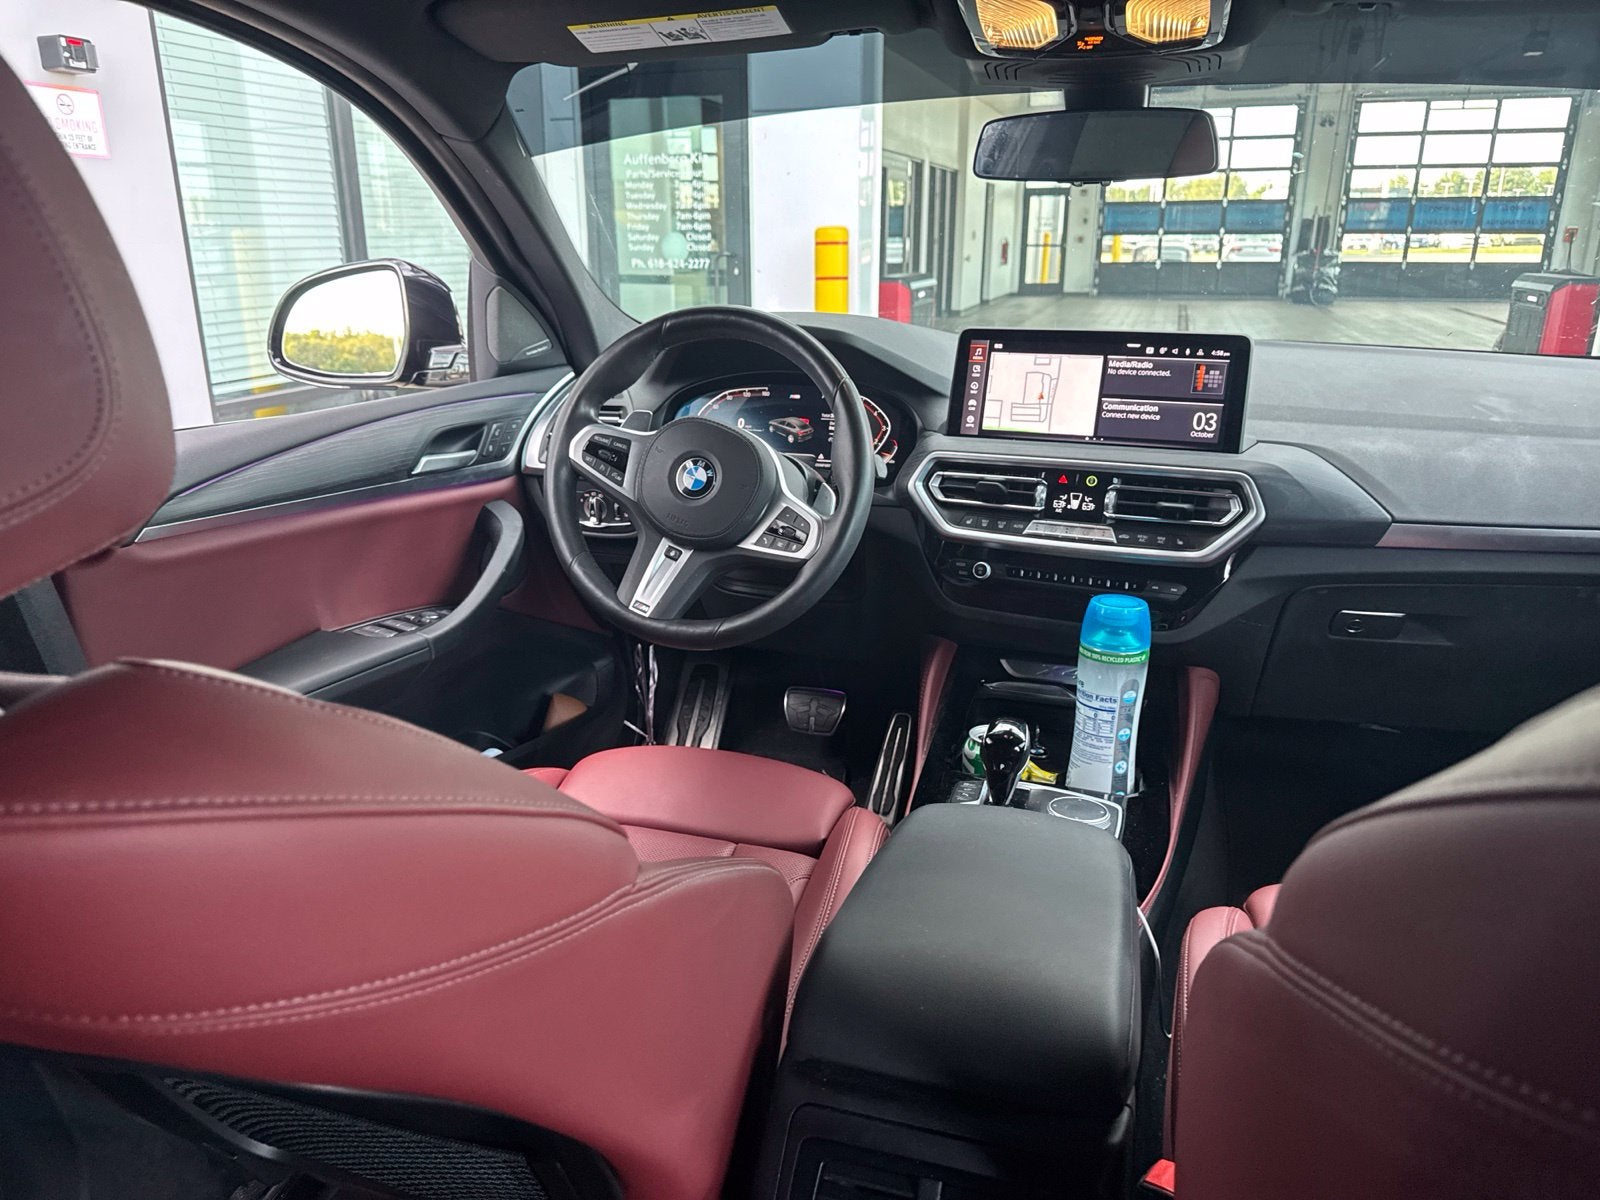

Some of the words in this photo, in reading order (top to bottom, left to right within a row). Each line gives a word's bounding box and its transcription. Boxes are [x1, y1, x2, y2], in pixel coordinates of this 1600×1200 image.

[1108, 360, 1154, 370] Media/Radio
[1102, 402, 1159, 413] Communication
[1101, 411, 1127, 419] Connect
[737, 417, 745, 429] 0
[1192, 412, 1218, 431] 03
[1189, 430, 1215, 439] October
[1101, 655, 1124, 663] RECYCLED
[1095, 694, 1118, 704] Facts
